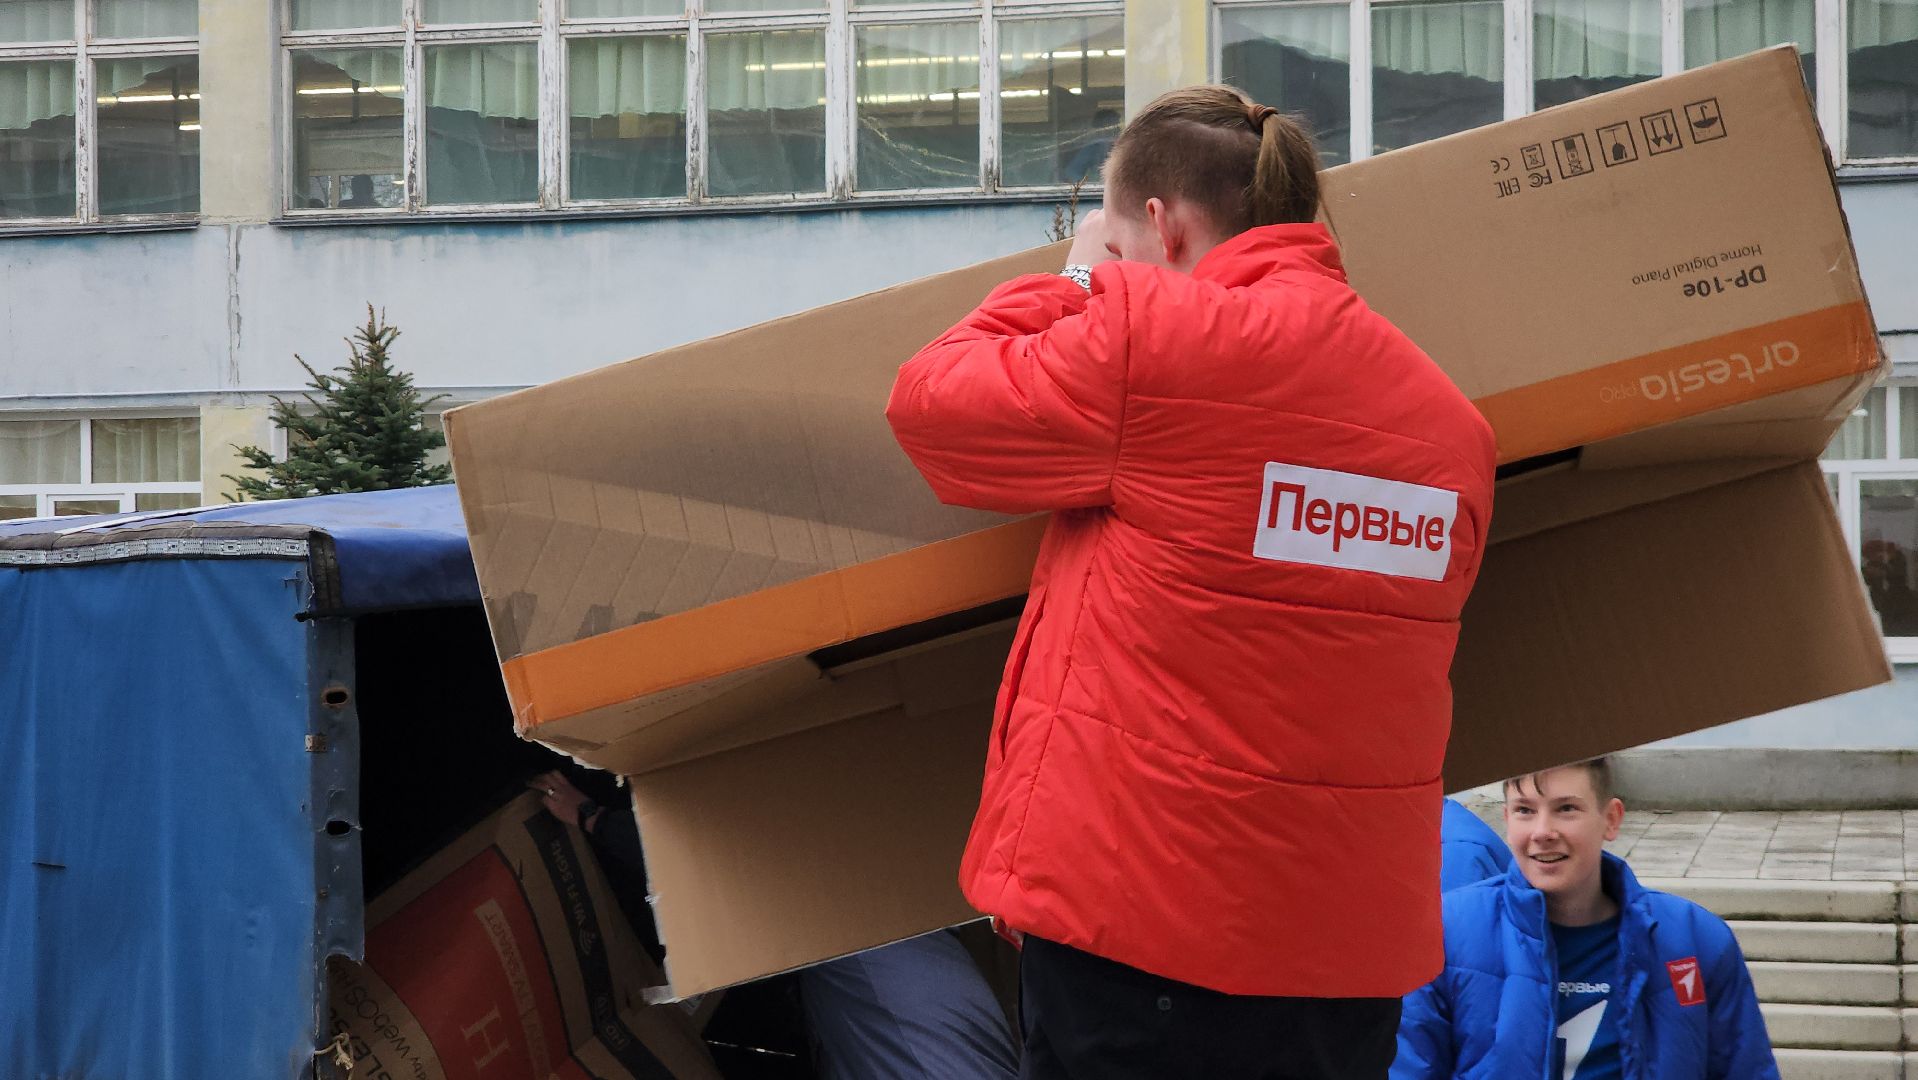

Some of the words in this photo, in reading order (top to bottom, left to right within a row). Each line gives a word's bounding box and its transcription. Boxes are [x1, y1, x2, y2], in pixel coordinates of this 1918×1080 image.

[1721, 244, 1762, 264] Home
[1631, 267, 1671, 286] Piano
[1672, 255, 1719, 280] Digital
[1683, 264, 1768, 298] DP-10e
[1639, 340, 1801, 403] artesia
[1267, 480, 1446, 553] Первые
[1557, 981, 1611, 997] ервые
